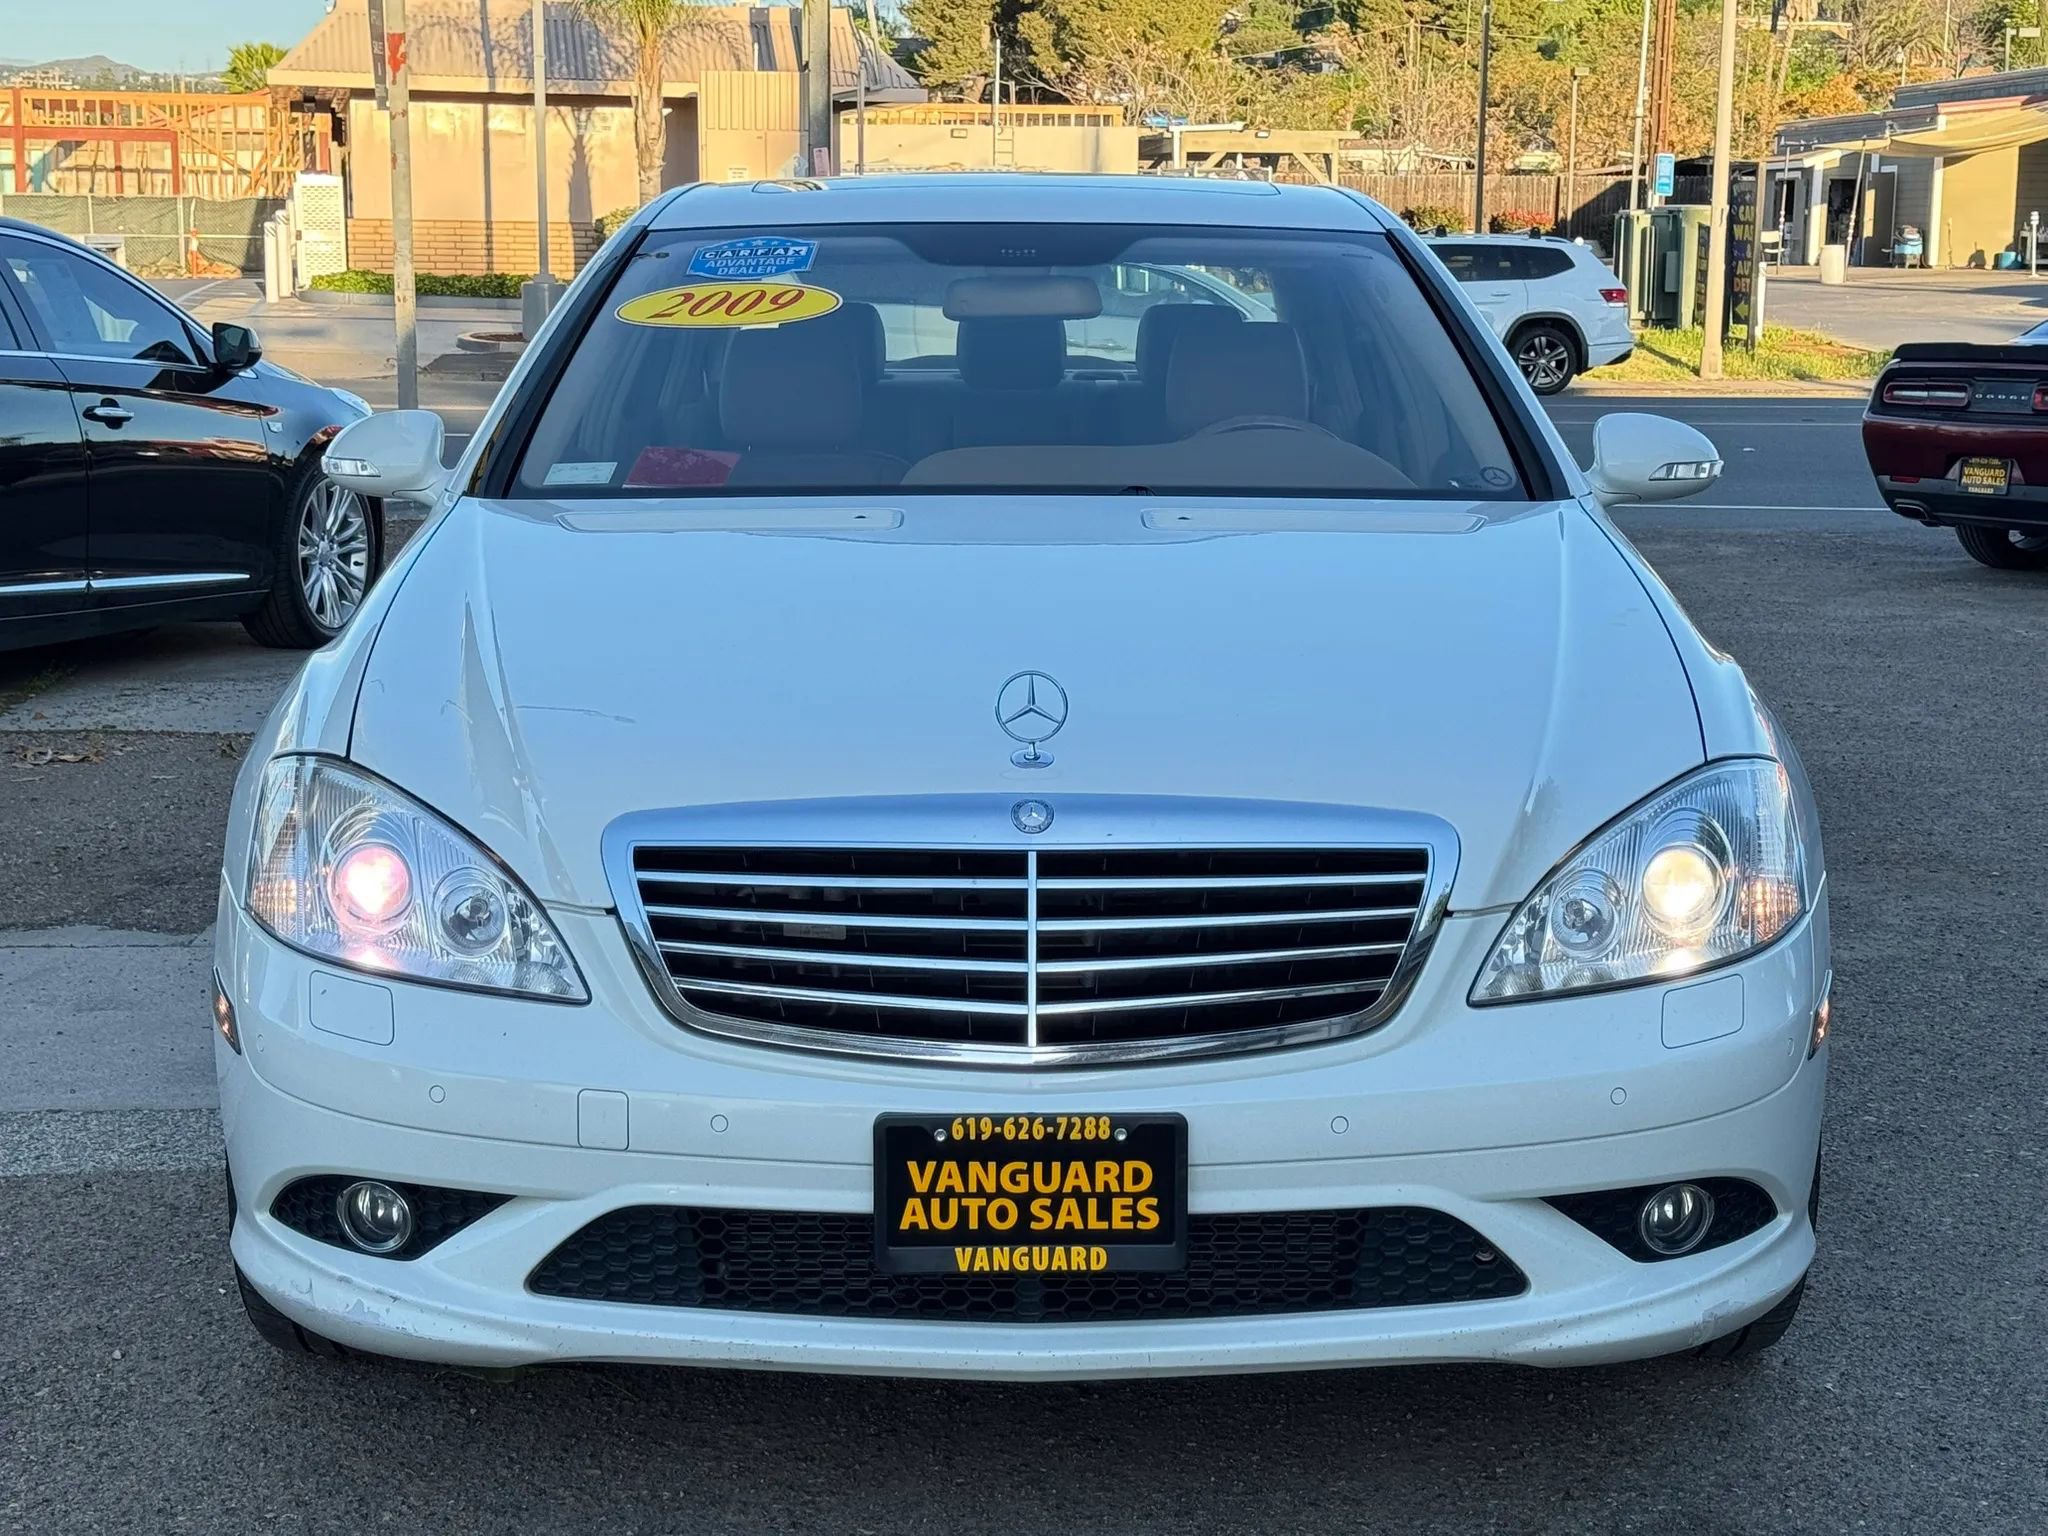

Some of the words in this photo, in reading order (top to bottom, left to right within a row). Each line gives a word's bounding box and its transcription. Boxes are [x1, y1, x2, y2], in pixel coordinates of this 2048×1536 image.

[703, 247, 806, 259] CARFAX
[705, 257, 795, 268] ADVANTAGE
[717, 266, 777, 275] DEALER
[647, 288, 806, 320] 2009
[1961, 475, 1981, 485] AUTO
[1982, 476, 2006, 486] SALES
[1964, 467, 2005, 477] VANGUARD
[951, 1116, 1111, 1141] 619-626-7288
[907, 1160, 1153, 1193] VANGUARD
[899, 1197, 1019, 1230] AUTO
[1029, 1197, 1160, 1230] SALES
[955, 1247, 1108, 1272] VANGUARD
